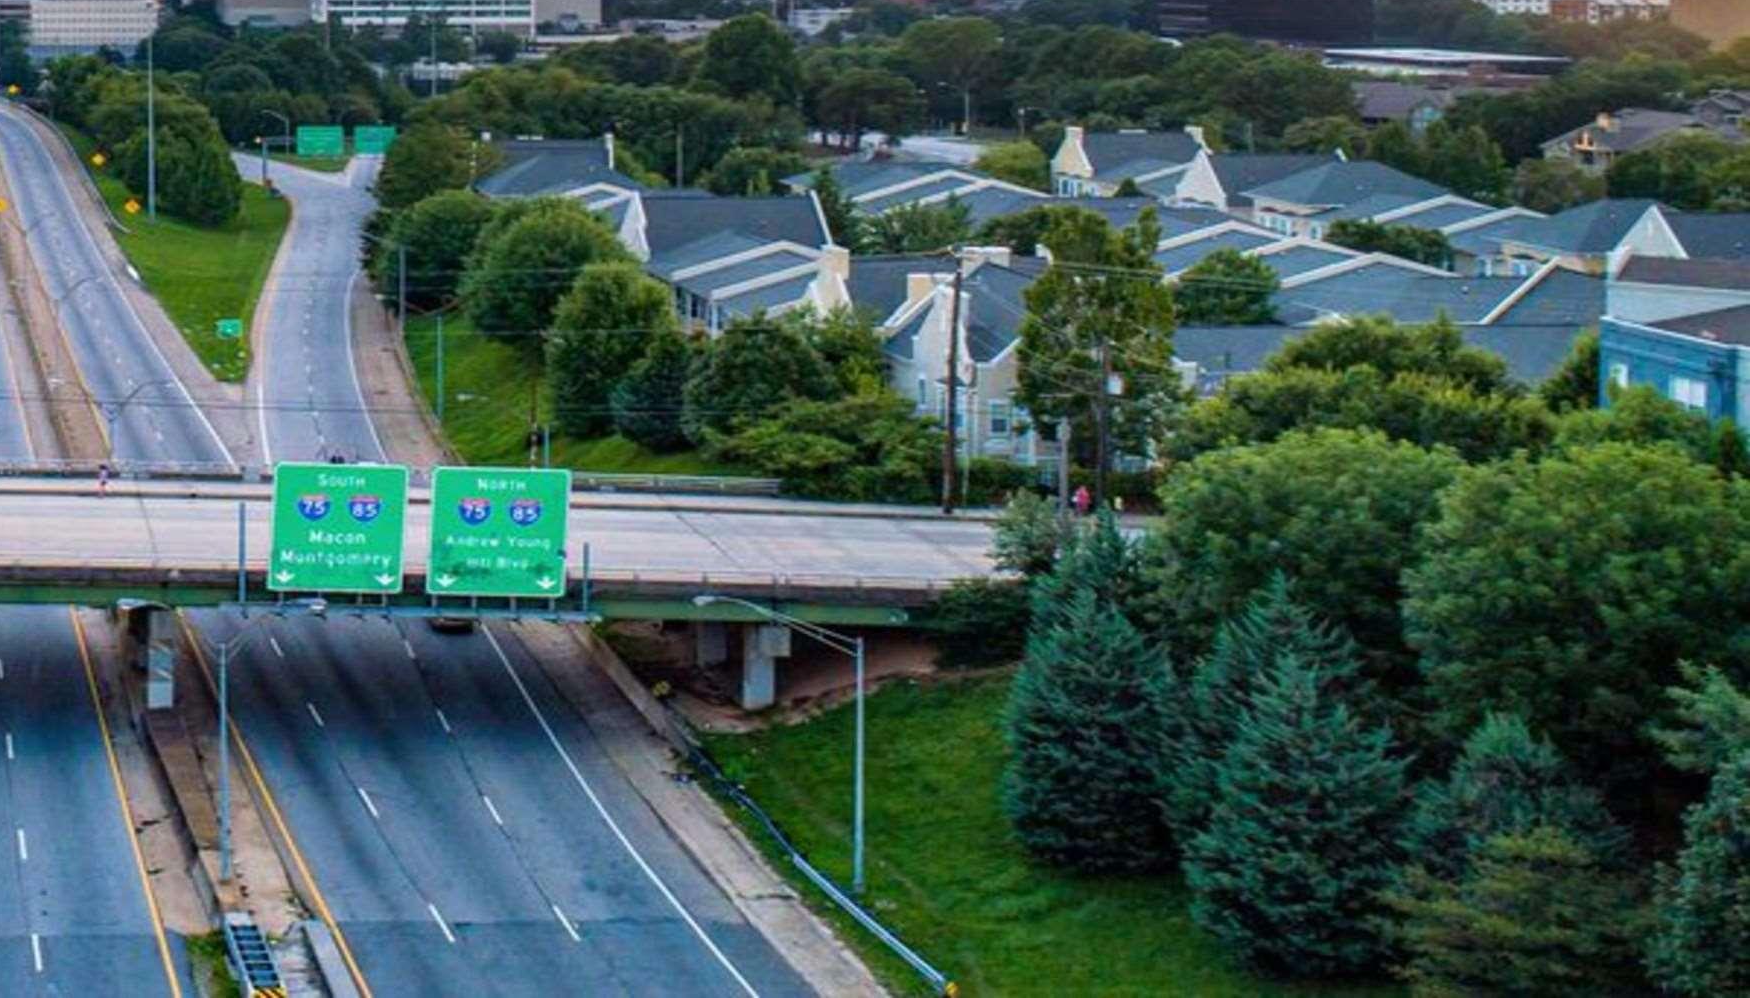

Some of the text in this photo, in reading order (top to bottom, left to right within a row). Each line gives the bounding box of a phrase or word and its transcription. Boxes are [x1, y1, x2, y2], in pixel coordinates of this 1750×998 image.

[317, 474, 366, 488] SOUTH
[477, 478, 526, 491] NORTH
[303, 500, 377, 518] 75 85
[464, 504, 538, 522] 75 85
[309, 530, 367, 545] Macon
[446, 535, 551, 550] Andrew Young
[279, 549, 391, 568] Montgomery
